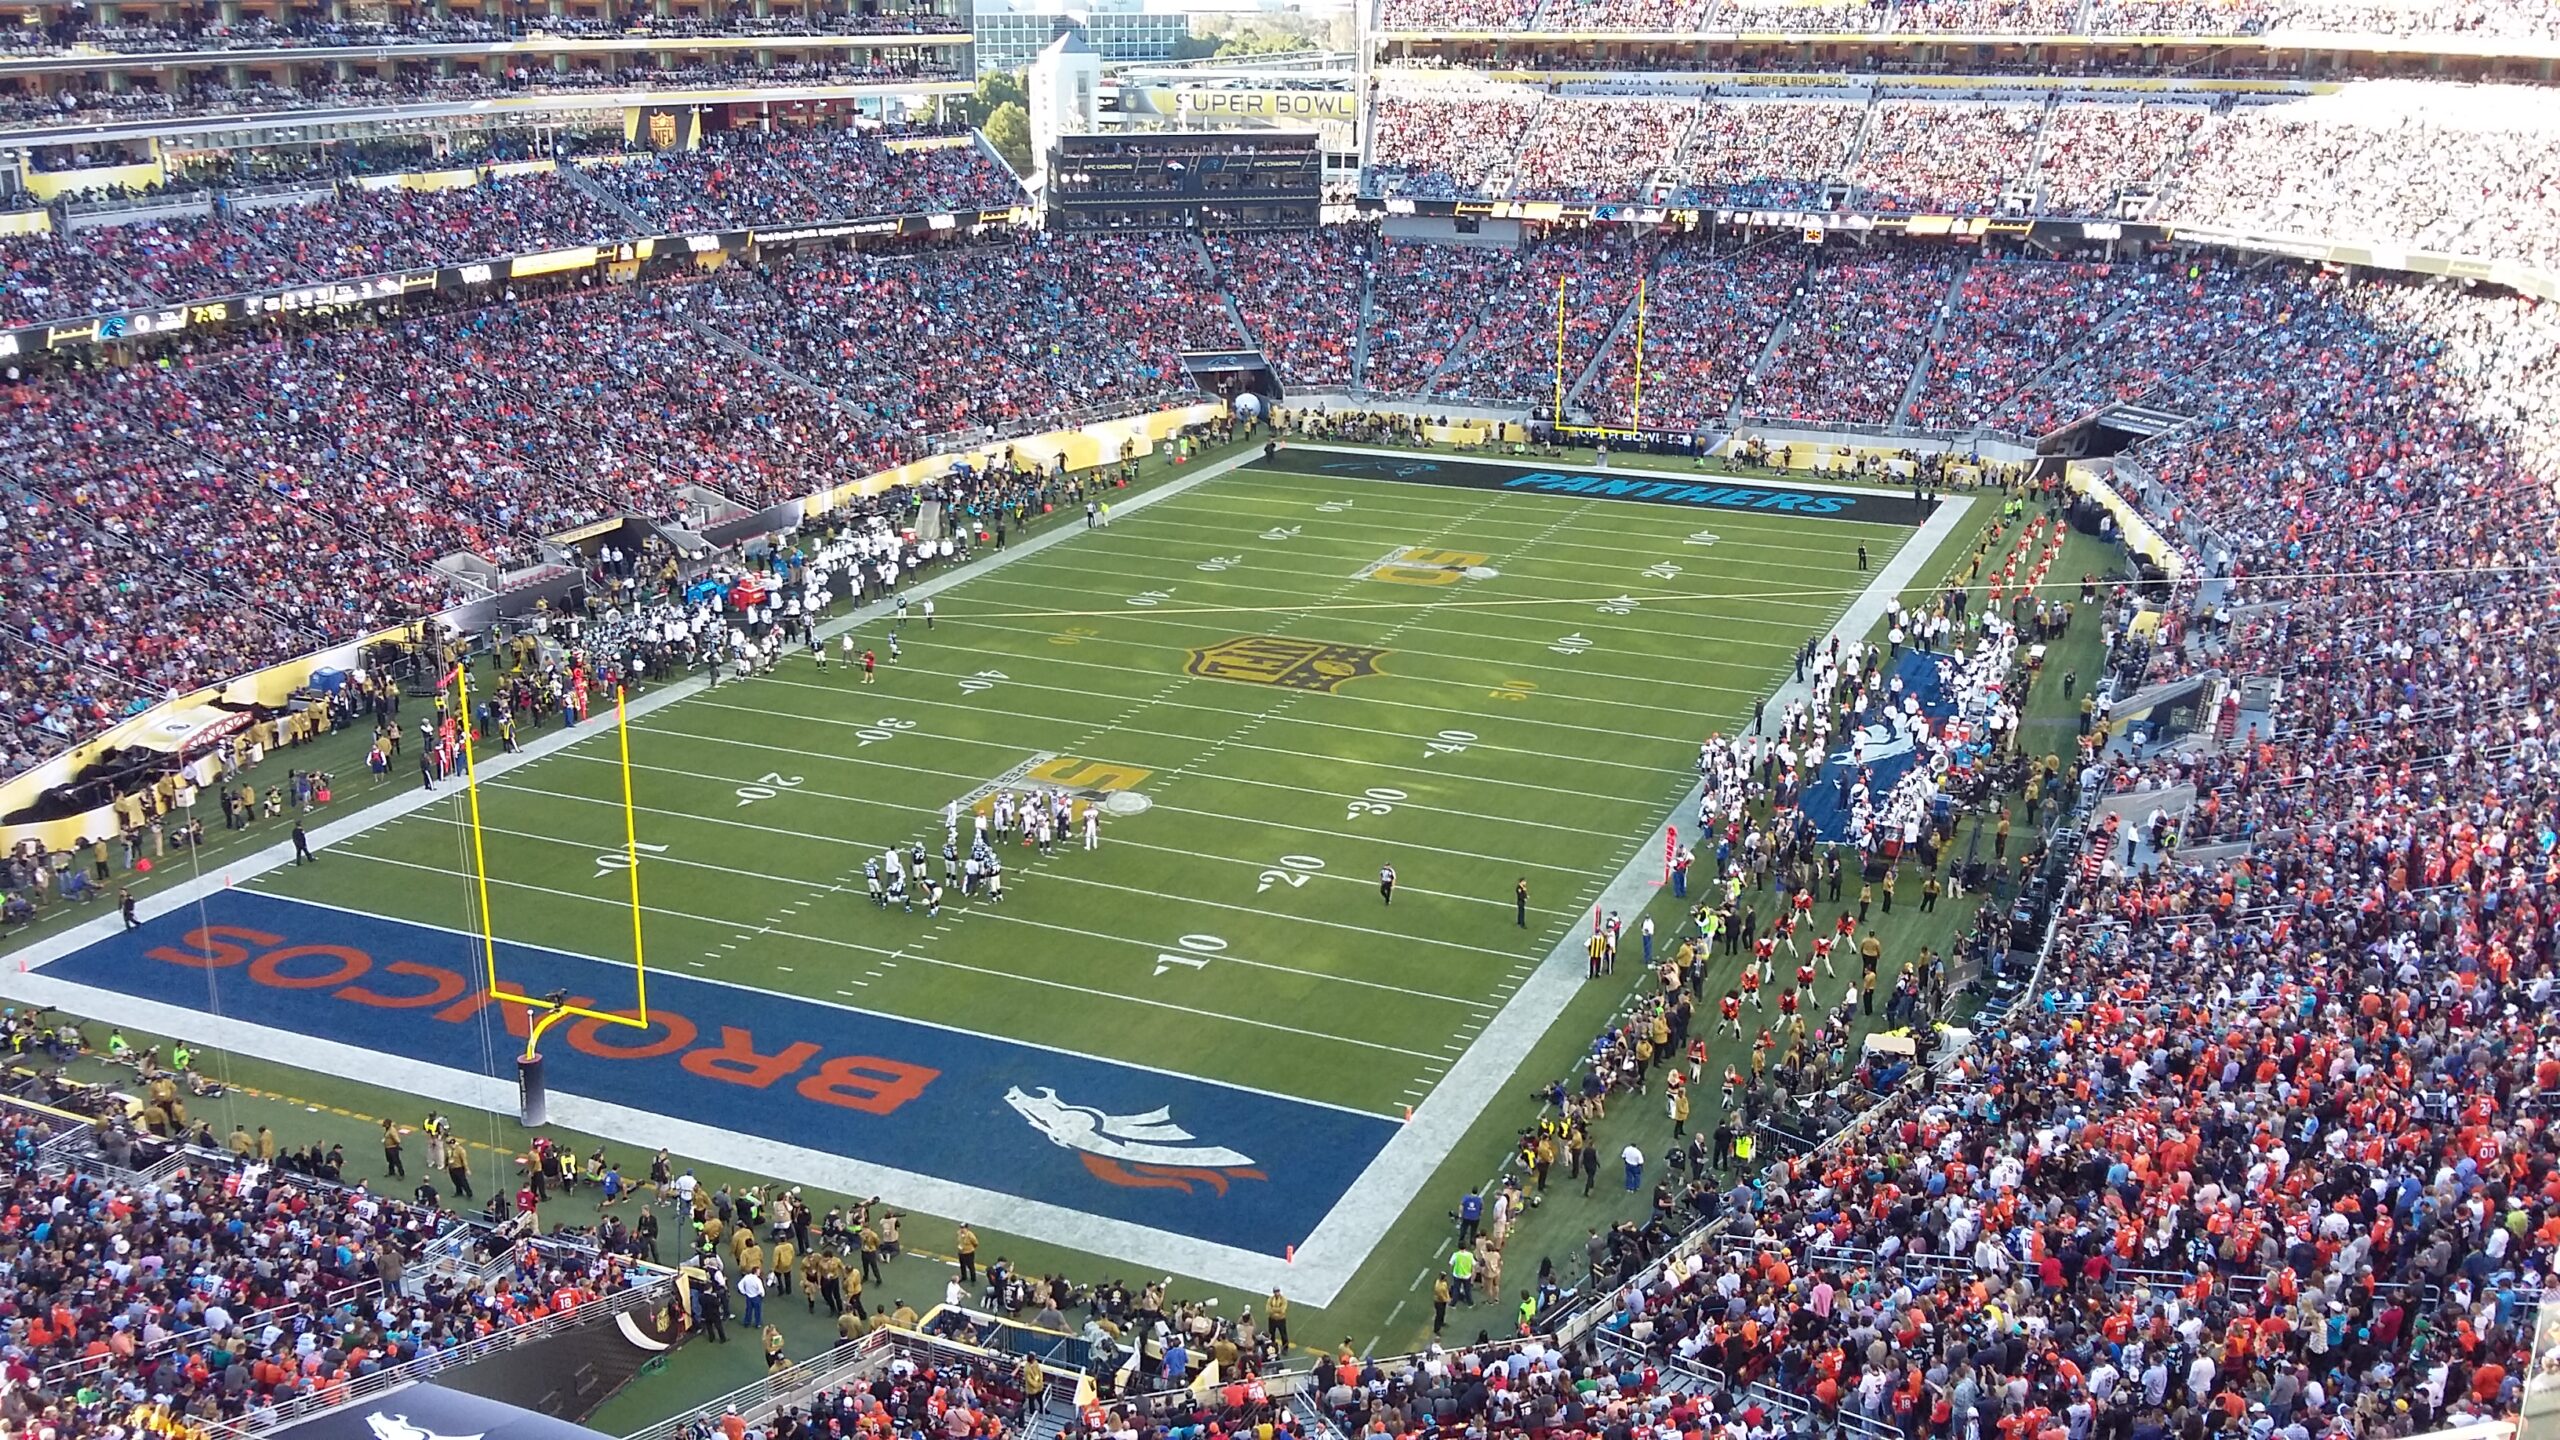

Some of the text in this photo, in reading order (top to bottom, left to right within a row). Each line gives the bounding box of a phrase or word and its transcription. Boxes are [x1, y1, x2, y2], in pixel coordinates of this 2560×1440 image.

[1748, 75, 1787, 85] SUPER
[1790, 76, 1825, 85] BOWL
[1174, 93, 1352, 115] SUPER BOWL
[653, 129, 673, 145] NFL
[1503, 473, 1857, 513] PANTHERS
[1682, 534, 1721, 546] 10
[1641, 564, 1683, 580] 20
[1596, 598, 1640, 615] 30
[1548, 637, 1593, 654] 40
[1203, 639, 1320, 682] NFL
[957, 669, 1010, 690] 40
[1488, 680, 1538, 700] 50
[855, 717, 916, 741] 30
[1426, 730, 1478, 753] 40
[1000, 758, 1045, 783] SUPER
[736, 772, 804, 801] 20
[1347, 788, 1408, 815] 30
[595, 840, 670, 869] 10
[1259, 855, 1325, 888] 20
[1157, 934, 1228, 970] 10
[145, 925, 942, 1116] BRONCOS
[2479, 1149, 2496, 1159] 00
[560, 1297, 572, 1310] 18
[1874, 1384, 1882, 1394] 3
